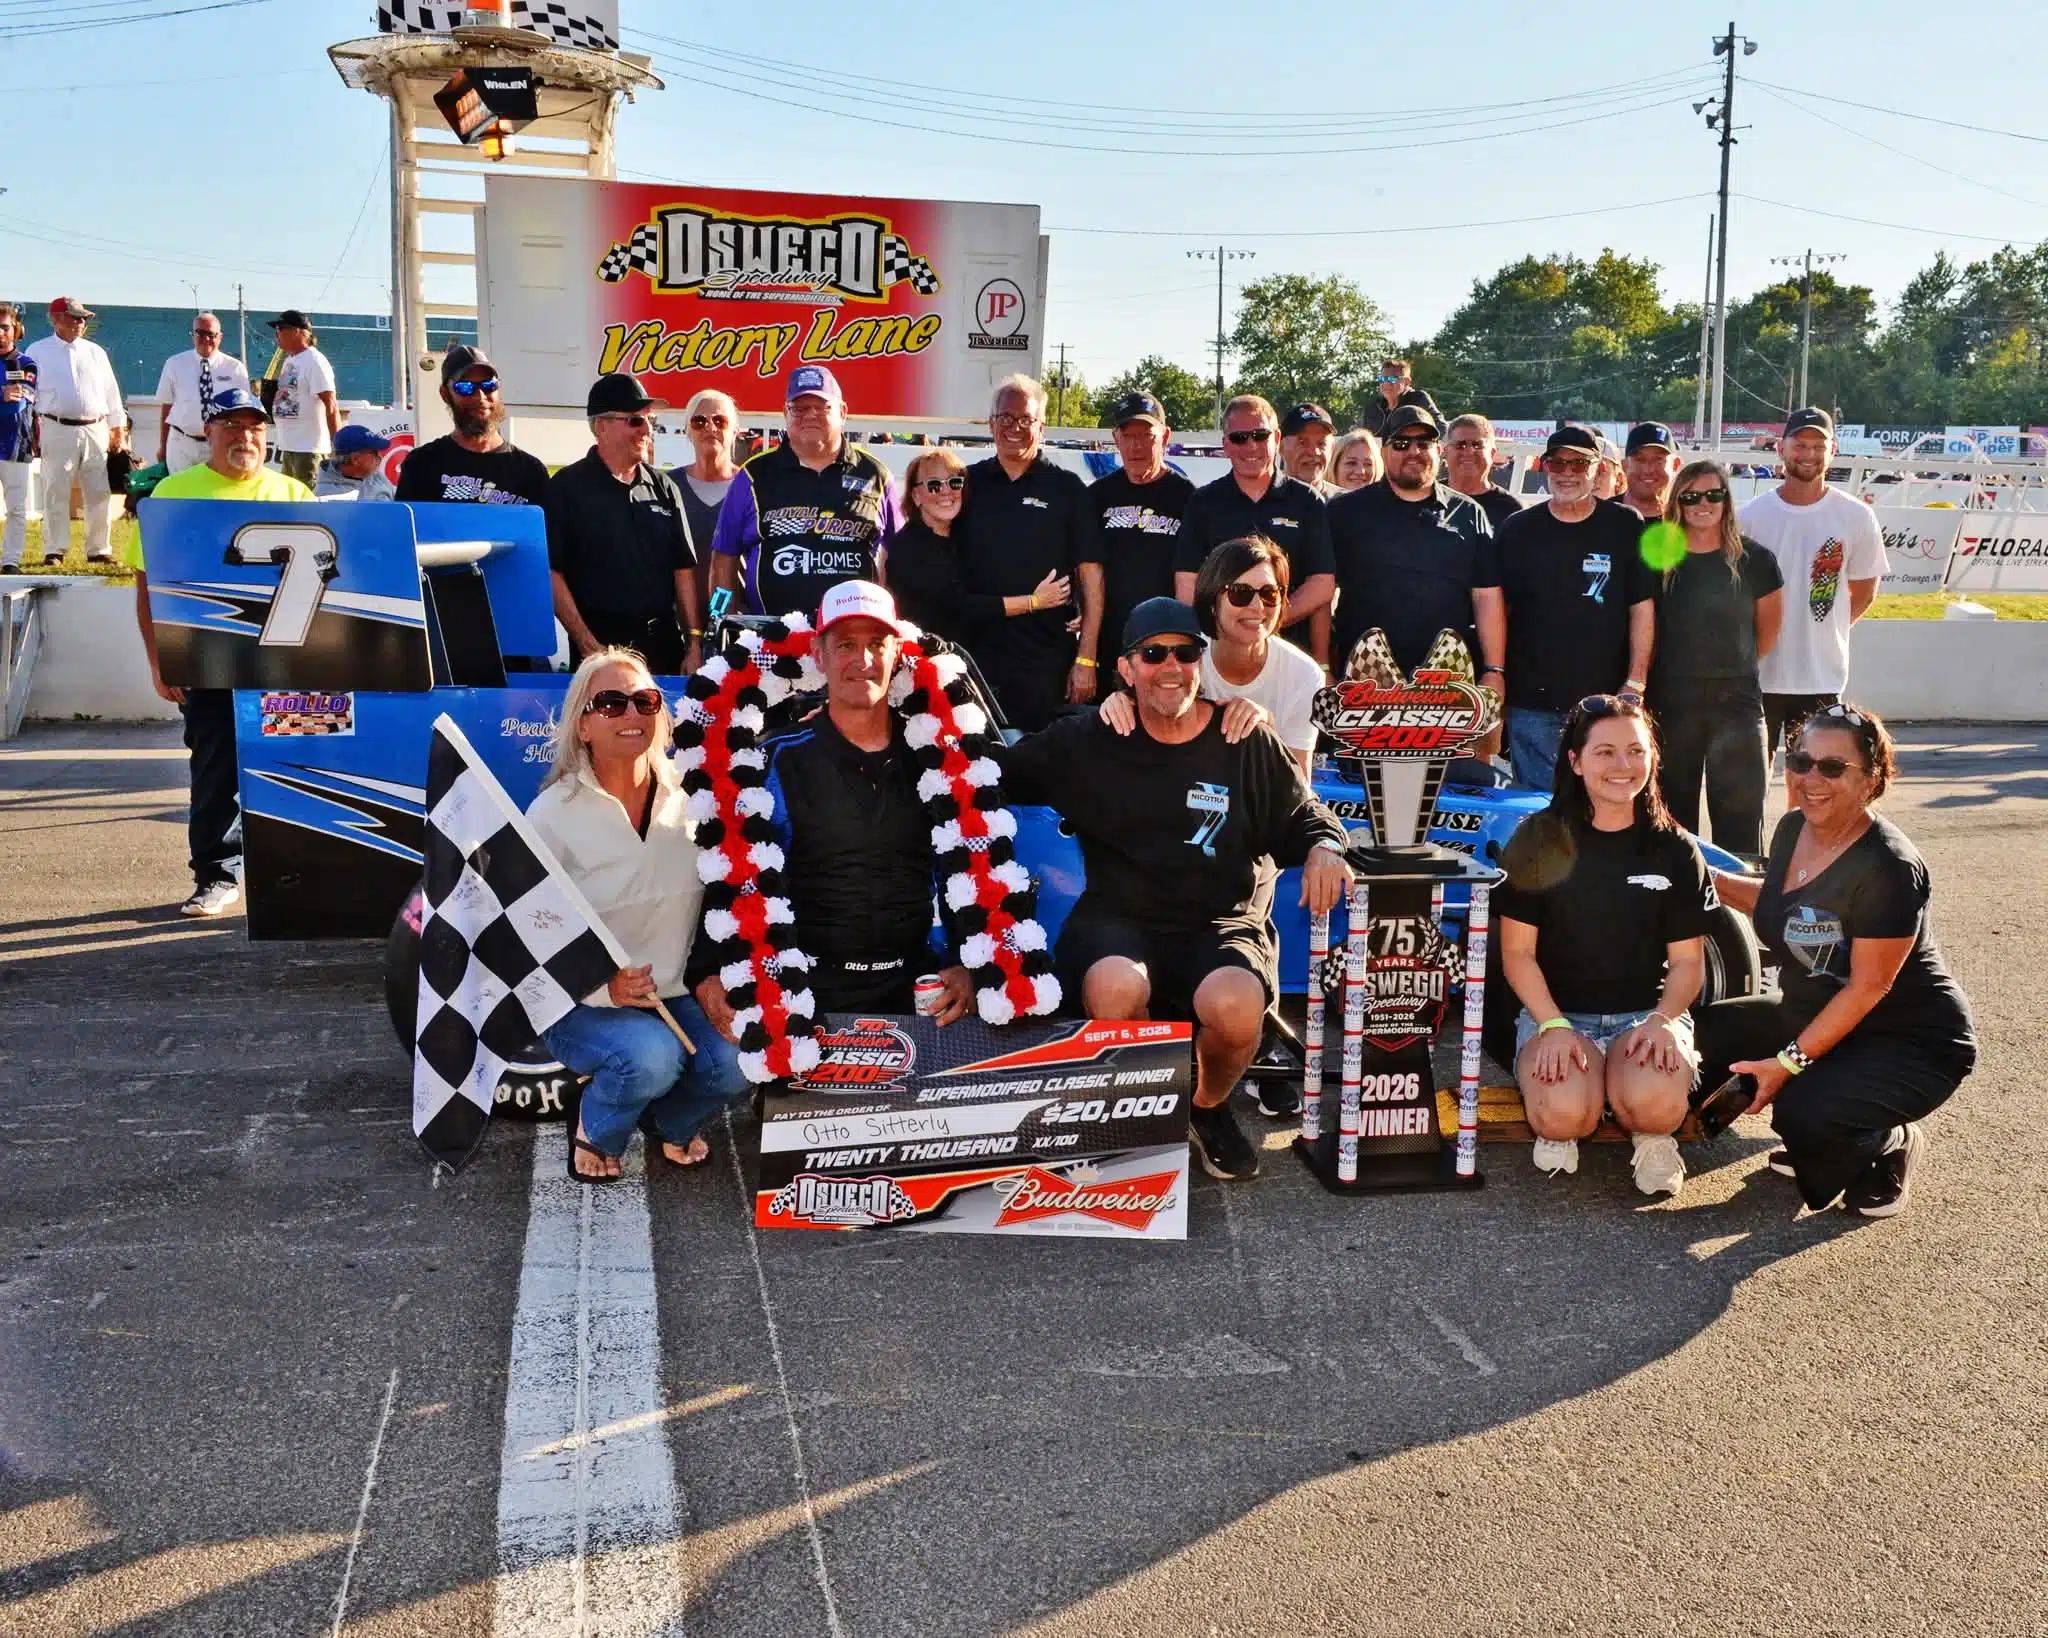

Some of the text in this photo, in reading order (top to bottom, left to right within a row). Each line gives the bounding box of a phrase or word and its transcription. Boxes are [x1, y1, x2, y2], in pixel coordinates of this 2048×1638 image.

[484, 80, 527, 89] WHELEN
[664, 212, 879, 294] OSWEGO
[705, 266, 836, 291] Speedway
[984, 293, 1018, 323] JP
[598, 309, 942, 376] Victory Lane
[377, 423, 410, 439] ERAGE
[1977, 432, 2015, 444] Pice
[1949, 440, 2015, 455] Chper
[762, 507, 819, 522] ROYAL
[800, 517, 873, 539] PURPLE
[810, 551, 862, 568] HOMES
[231, 522, 338, 646] 7
[1337, 681, 1462, 705] Budweiser
[264, 695, 349, 713] ROLLO
[1336, 710, 1475, 727] CLASSIC
[1361, 727, 1446, 748] 200
[522, 743, 556, 764] Ho
[1191, 793, 1225, 804] NICOTRA
[1380, 918, 1416, 956] 75
[1787, 923, 1834, 934] NICOTRA
[845, 958, 904, 971] Otto Sitterly
[1376, 958, 1415, 967] YEARS
[1365, 970, 1445, 1002] SWEGO
[1362, 994, 1428, 1014] Speedway
[1370, 1013, 1415, 1021] 1951-2026
[1084, 1030, 1117, 1043] SEPT
[821, 1051, 905, 1066] ASSIC
[811, 1065, 880, 1083] 200
[916, 1067, 1176, 1103] SUPERMODIFIED CLASSIC WINNER
[1361, 1073, 1420, 1102] 2026
[494, 1079, 568, 1114] Hoo
[773, 1112, 798, 1121] PAY
[813, 1109, 834, 1117] THE
[836, 1105, 874, 1115] ORDER
[875, 1104, 892, 1112] OF
[1040, 1094, 1180, 1126] $20,000
[803, 1113, 950, 1145] Otto Sitterly
[804, 1134, 1079, 1169] TWENTY THOUSAND XX/100
[797, 1178, 891, 1217] OSWEGO
[992, 1178, 1178, 1213] Budweiser
[816, 1205, 869, 1217] Speedway
